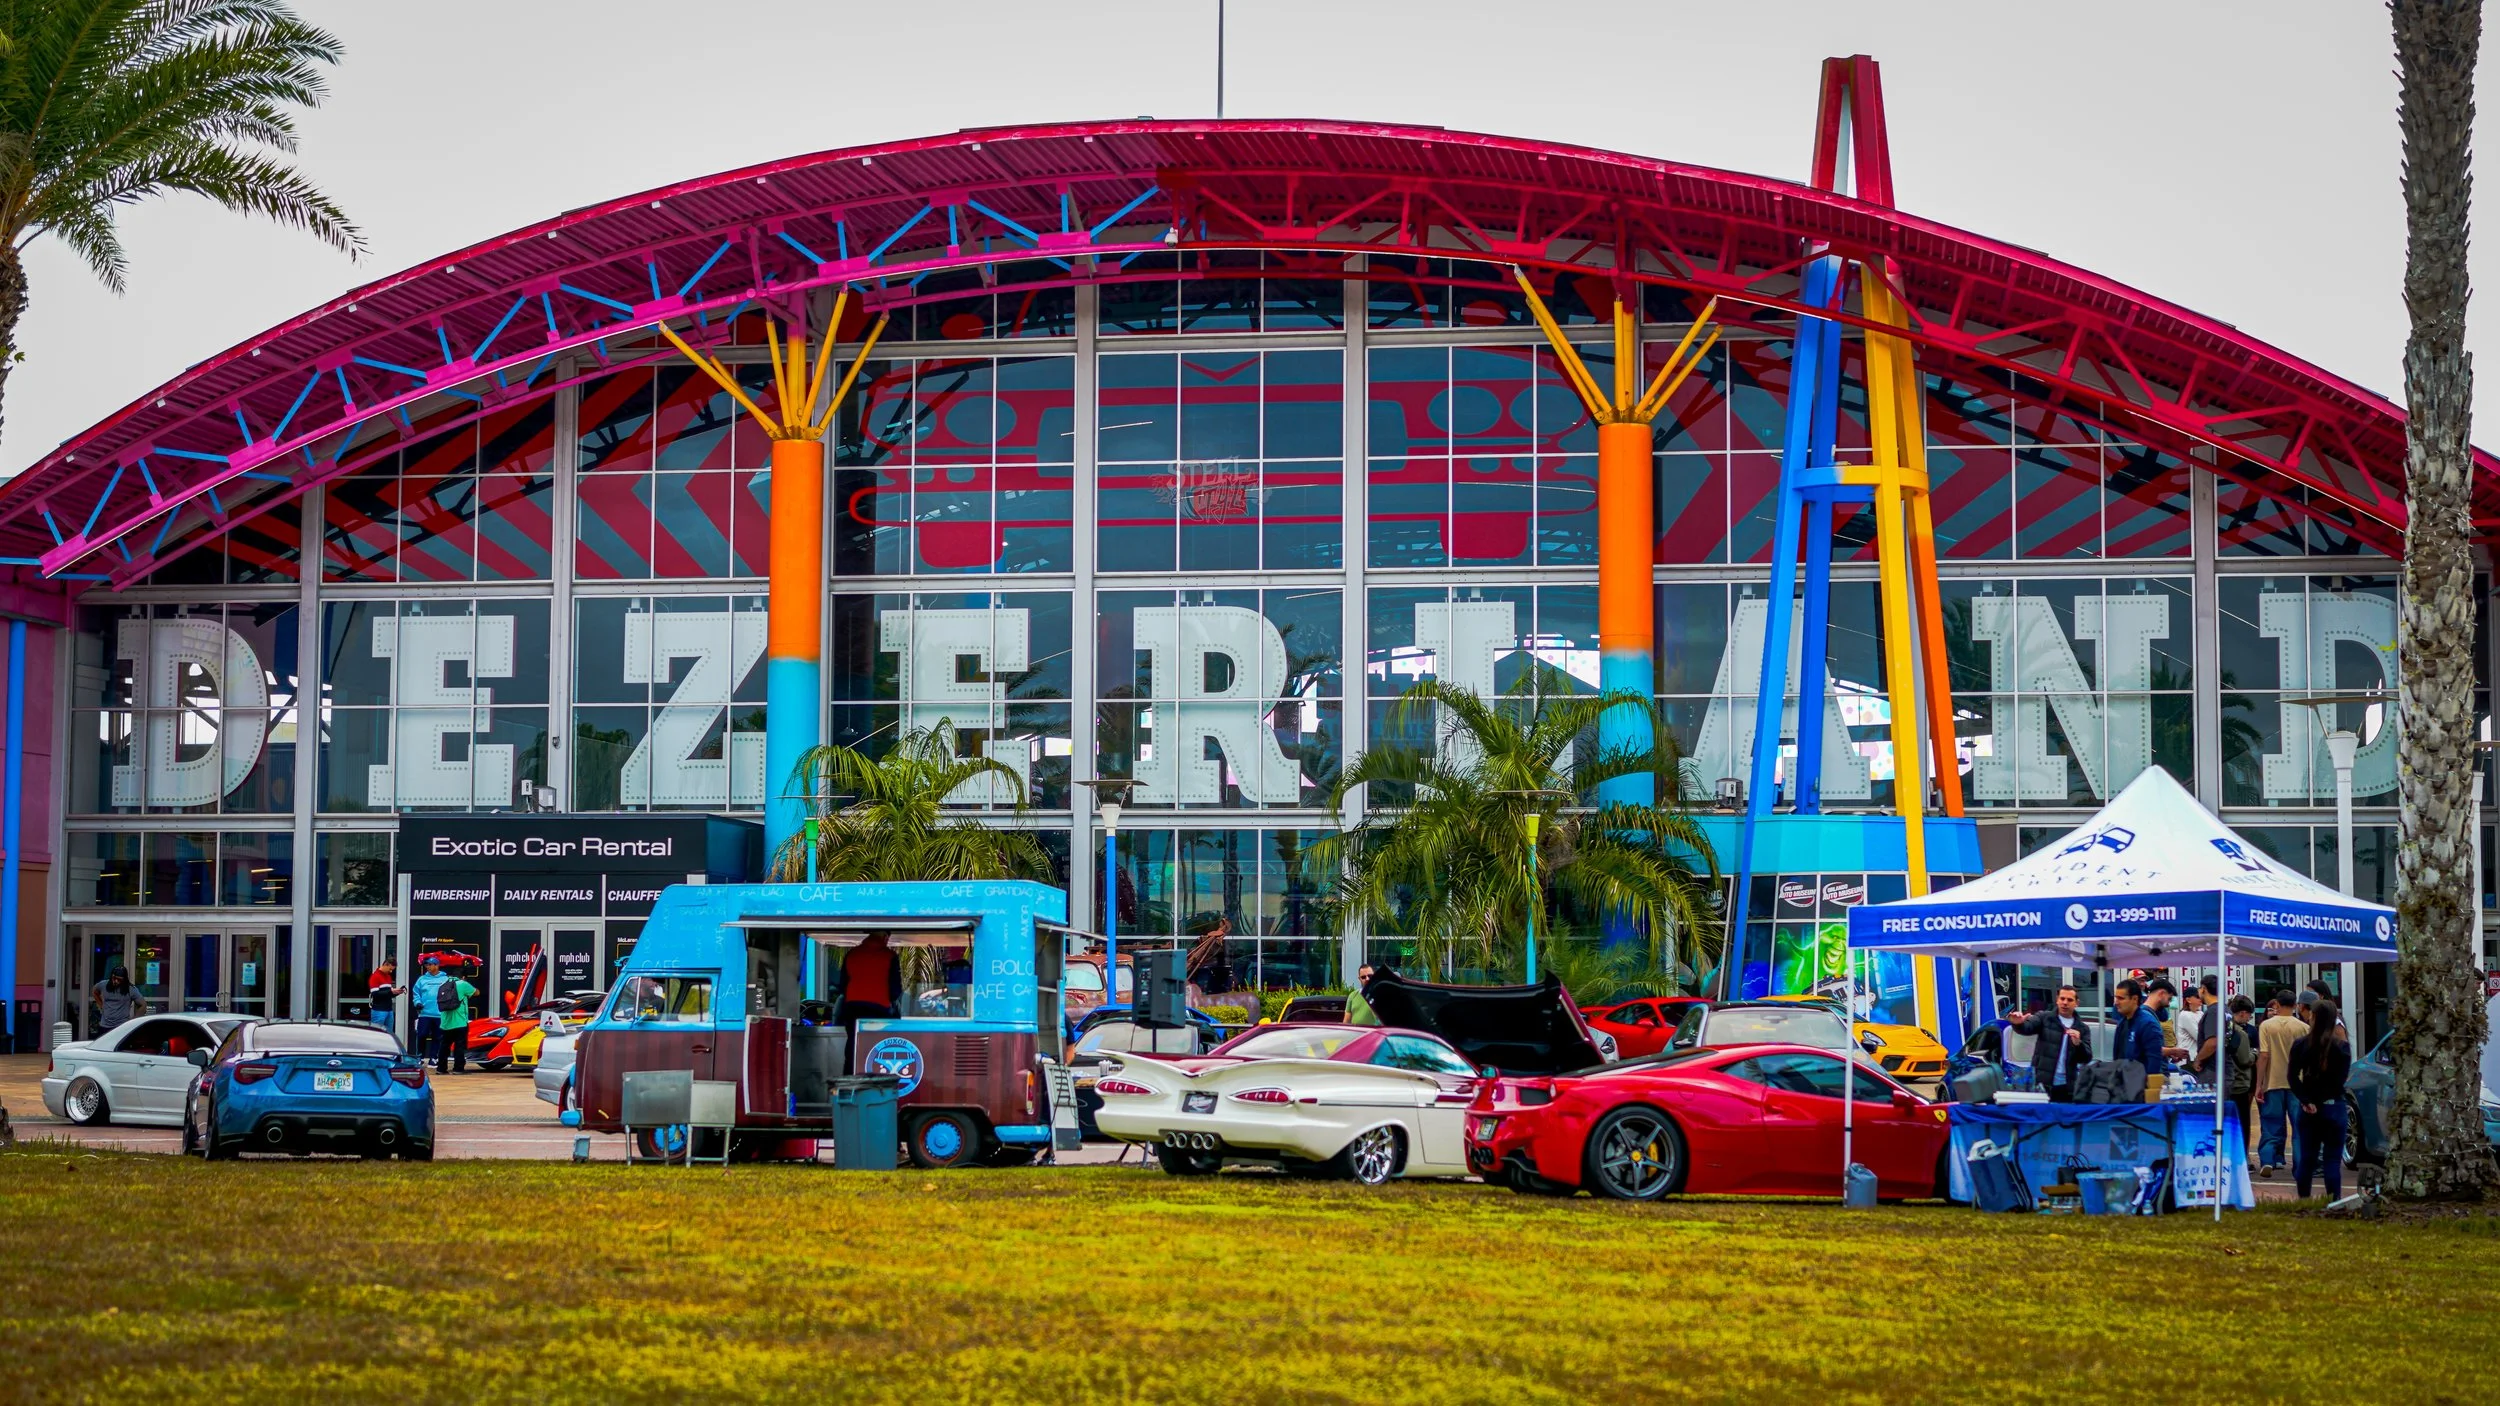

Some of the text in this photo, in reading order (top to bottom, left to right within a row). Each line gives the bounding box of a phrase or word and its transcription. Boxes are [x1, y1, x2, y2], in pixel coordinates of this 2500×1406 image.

[1167, 456, 1258, 489] STEEL
[431, 837, 673, 857] Exotic Car Rental
[413, 889, 491, 901] MEMBERSHIP
[504, 889, 594, 901] DAILY RENTALS
[608, 889, 664, 901] CHAUFFE
[1779, 888, 1816, 899] AUTO MUSEUM
[1822, 886, 1864, 901] AUTO MUSEUM
[1882, 911, 2042, 933] FREE CONSULTATION
[2092, 906, 2177, 923] 321-999-1111
[2249, 909, 2361, 934] FREE CONSULTATION
[505, 952, 521, 965] mph
[559, 953, 590, 966] mph club
[974, 981, 1006, 1000] AFÉ
